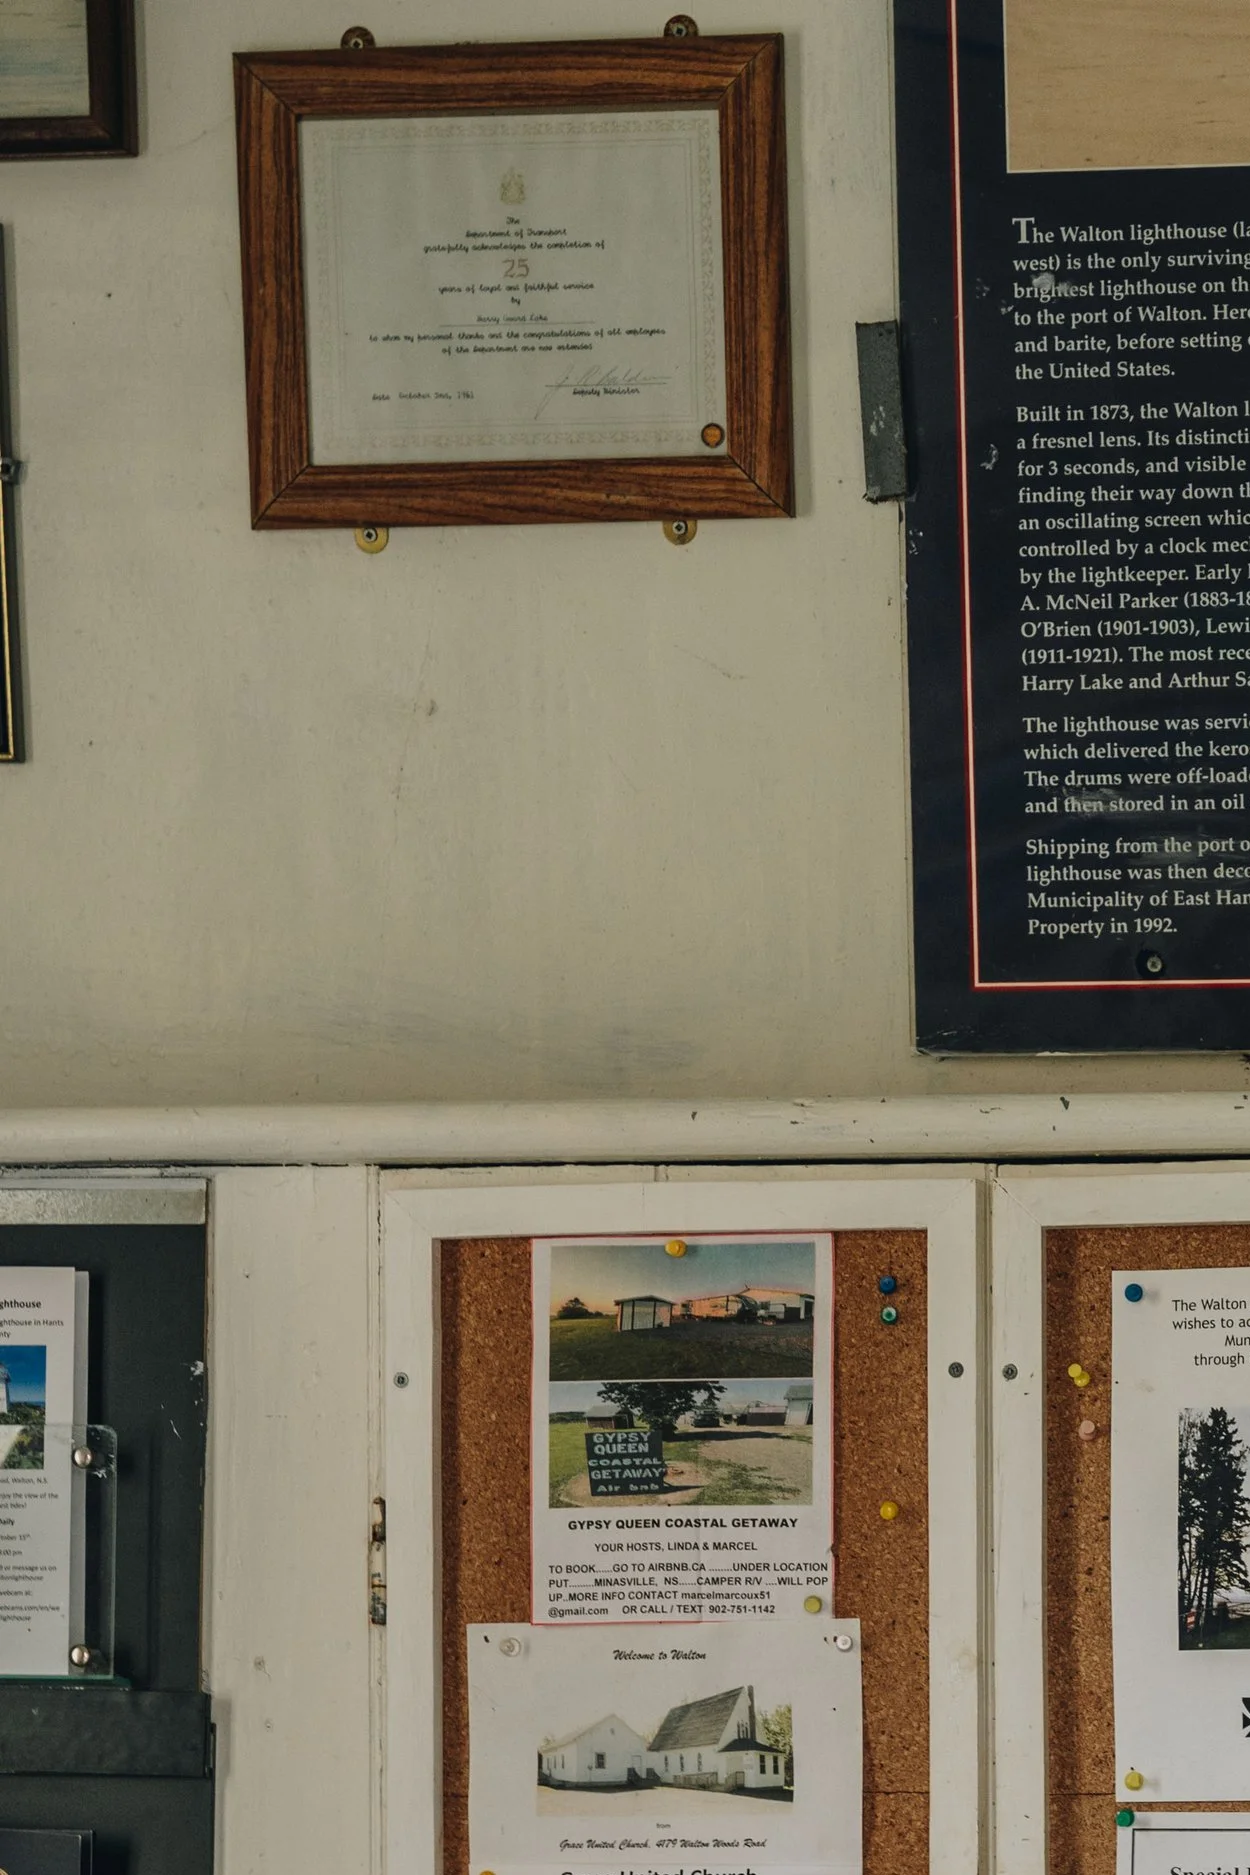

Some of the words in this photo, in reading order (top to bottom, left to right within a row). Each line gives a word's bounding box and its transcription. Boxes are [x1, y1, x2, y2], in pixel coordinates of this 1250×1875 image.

[502, 258, 530, 279] 25
[1015, 363, 1044, 381] the
[1049, 361, 1111, 379] United
[1117, 360, 1175, 378] States.
[1019, 567, 1043, 589] by
[1047, 567, 1076, 584] the
[1081, 565, 1189, 588] lightkeeper.
[1194, 563, 1242, 585] Early
[1020, 595, 1040, 611] A.
[1046, 592, 1113, 611] McNeil
[1119, 591, 1179, 609] Parker
[1022, 716, 1058, 733] The
[1063, 715, 1159, 738] lighthouse
[1164, 718, 1200, 731] was
[1028, 919, 1105, 940] Property
[1110, 917, 1129, 934] in
[1133, 917, 1178, 933] 1992.
[1171, 1299, 1197, 1312] The
[1200, 1297, 1247, 1311] Walton
[1172, 1316, 1216, 1330] wishes
[1220, 1317, 1234, 1329] to
[1193, 1352, 1245, 1369] through
[593, 1432, 651, 1443] GYPSY
[594, 1443, 649, 1455] QUEEN
[588, 1458, 661, 1466] COASTAL
[590, 1468, 662, 1480] GETAWAY
[568, 1519, 612, 1531] GYPSY
[615, 1518, 661, 1530] QUEEN
[664, 1518, 728, 1529] COASTAL
[731, 1517, 798, 1528] GETAWAY
[594, 1542, 624, 1553] YOUR
[626, 1541, 665, 1552] HOSTS,
[667, 1541, 700, 1551] LINDA
[702, 1541, 710, 1551] &
[712, 1541, 758, 1551] MARCEL
[548, 1606, 609, 1619] @gmail.com
[622, 1605, 638, 1615] OR
[639, 1604, 668, 1614] CALL
[670, 1604, 674, 1614] /
[676, 1604, 704, 1614] TEXT
[708, 1604, 776, 1614] 902-751-1142
[612, 1649, 655, 1661] Welcome
[658, 1651, 668, 1661] to
[670, 1649, 707, 1661] Walton
